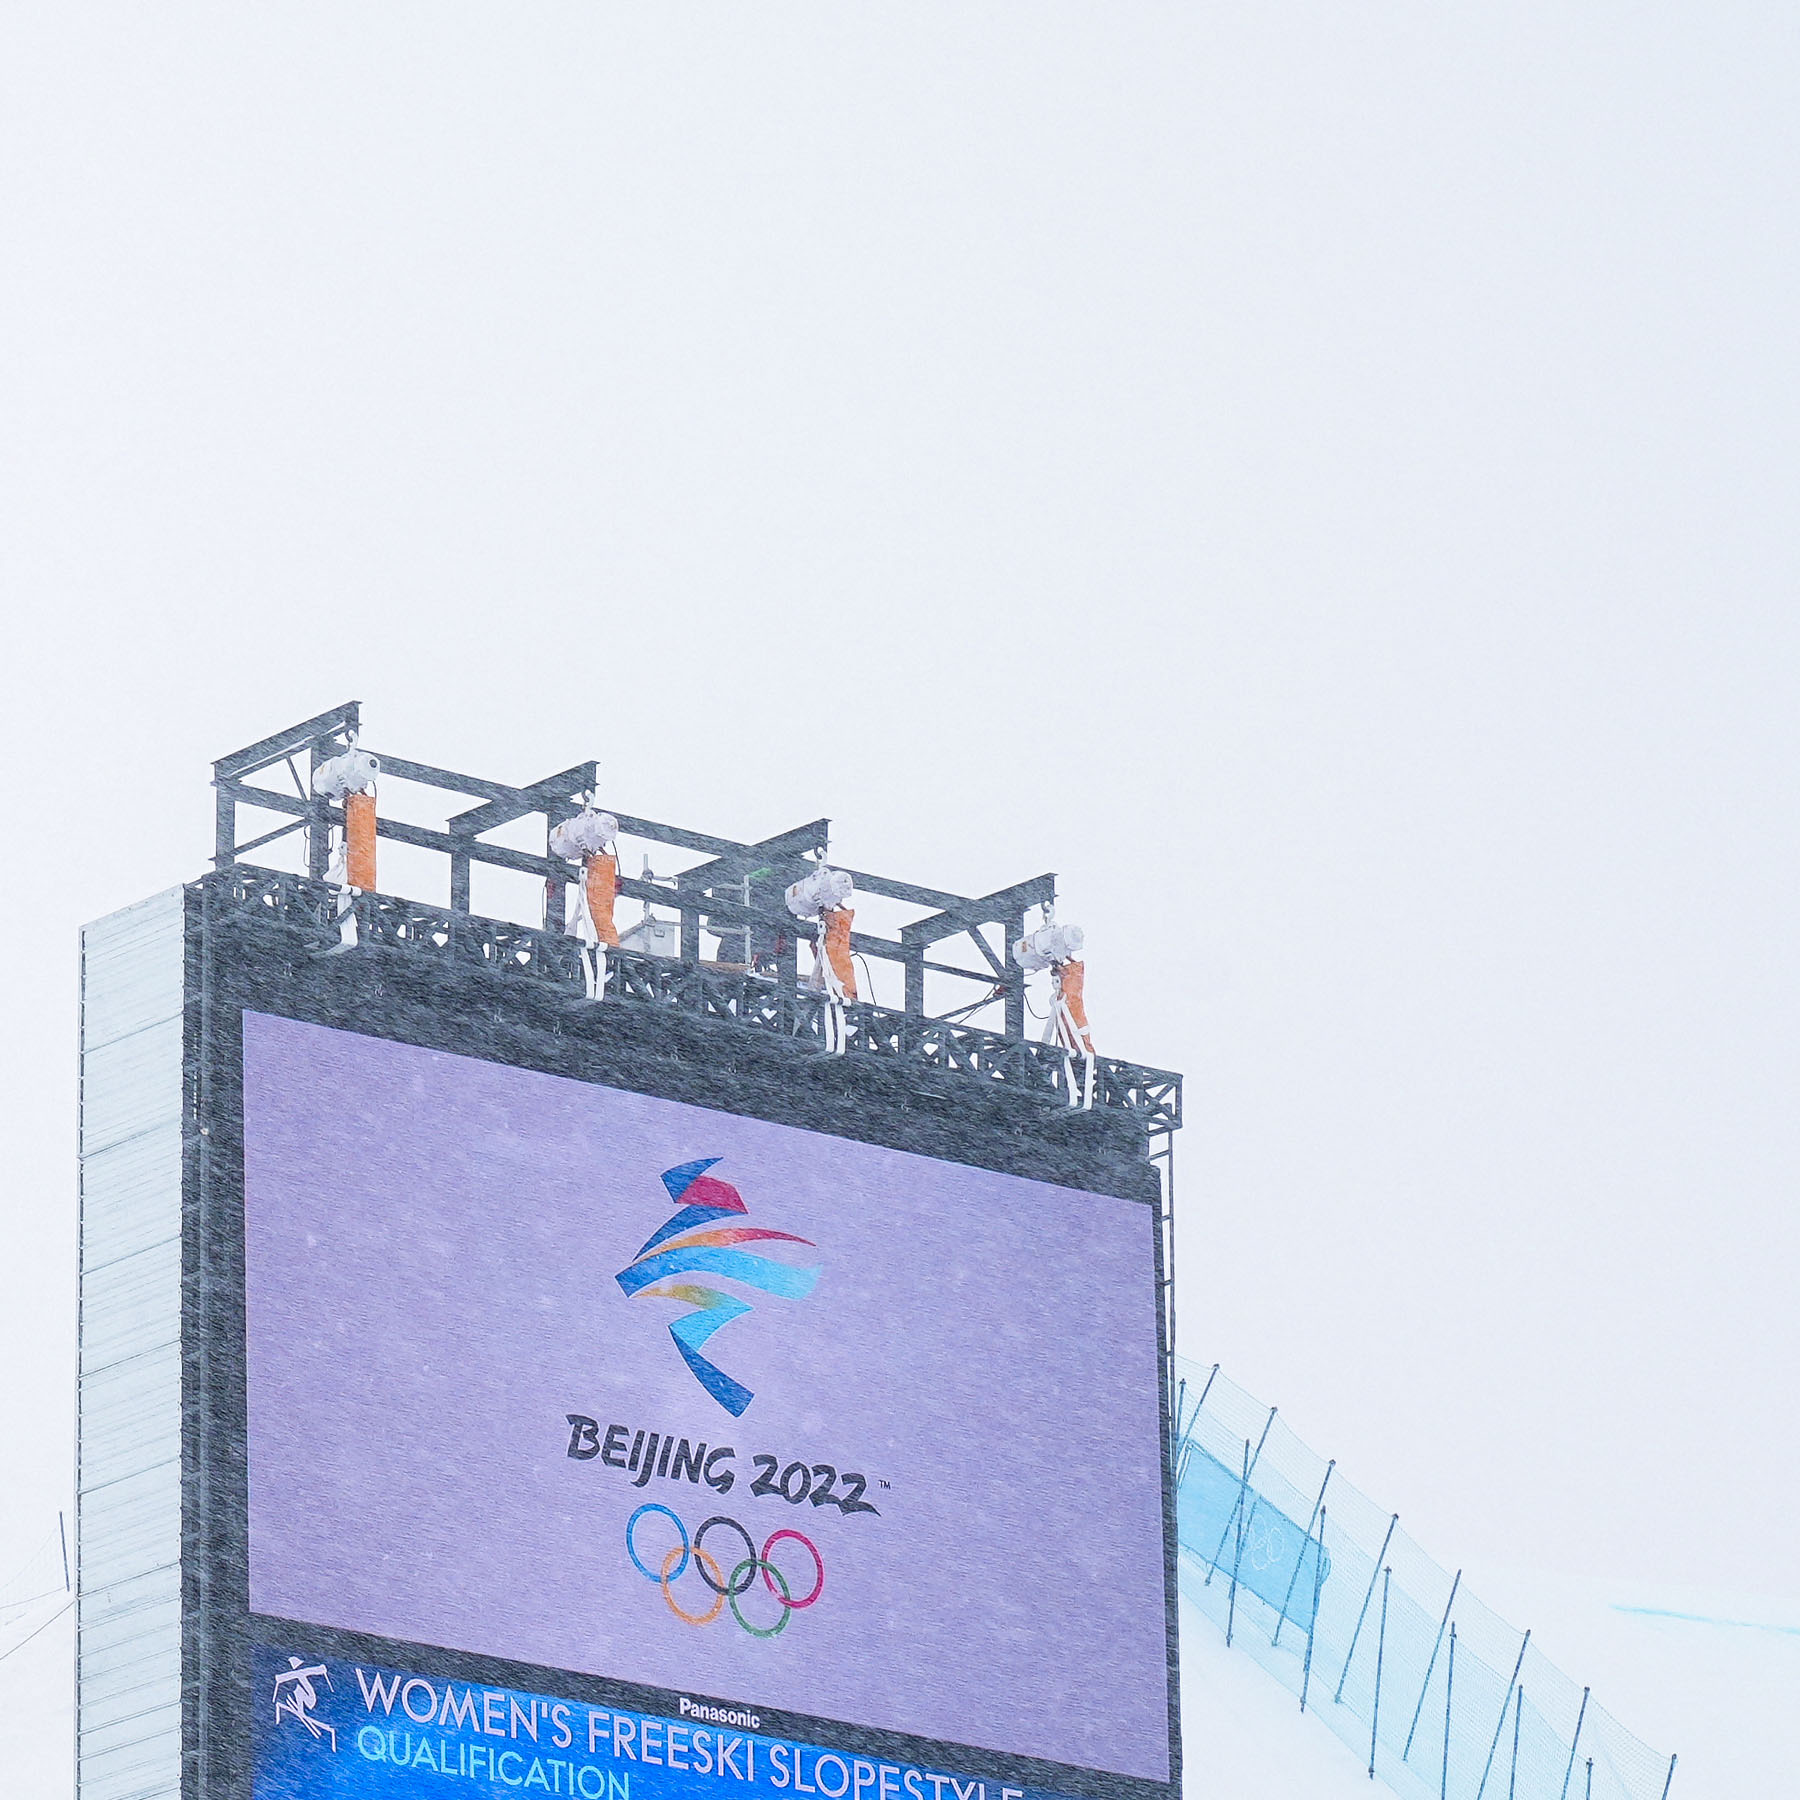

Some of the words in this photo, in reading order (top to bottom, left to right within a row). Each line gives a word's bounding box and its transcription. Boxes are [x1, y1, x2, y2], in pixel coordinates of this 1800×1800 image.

[565, 1413, 736, 1495] BEIJING
[749, 1453, 883, 1517] 2022
[354, 1667, 574, 1748] WOMEN'S
[587, 1709, 756, 1782] FREESKI
[679, 1697, 761, 1730] Panasonic
